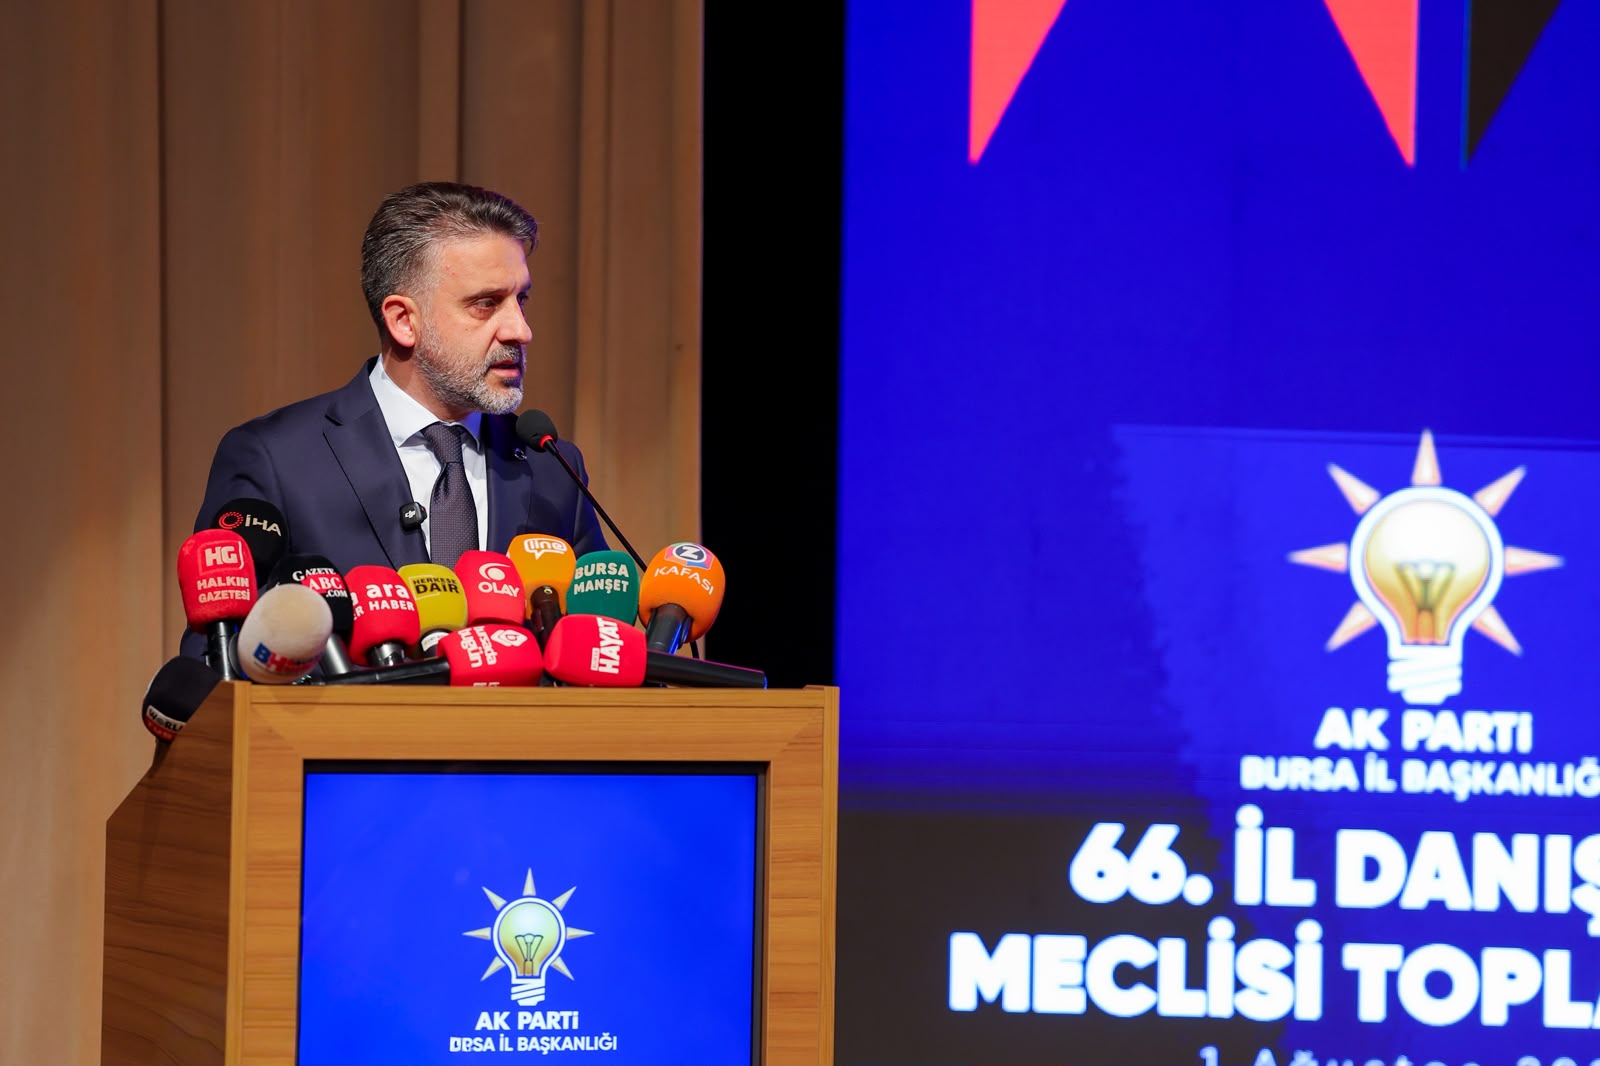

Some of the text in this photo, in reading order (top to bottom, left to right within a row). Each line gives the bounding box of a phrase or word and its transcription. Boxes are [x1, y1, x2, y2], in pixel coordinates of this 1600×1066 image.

[245, 514, 282, 537] İHA
[529, 538, 566, 551] line
[679, 546, 699, 560] Z
[204, 546, 239, 567] HG
[292, 567, 337, 581] GAZETE
[574, 562, 630, 580] BURSA
[196, 576, 250, 590] HALKIN
[309, 577, 343, 590] ABC
[413, 577, 457, 585] HERKESE
[573, 578, 630, 595] MANŞET
[654, 566, 714, 595] KAFASI
[198, 589, 251, 603] GAZETESİ
[326, 589, 349, 598] .COM
[365, 583, 411, 599] ara
[478, 581, 520, 598] OLAY
[368, 600, 416, 611] HABER
[596, 616, 625, 674] HAYAT
[1313, 706, 1391, 751] AK
[1239, 754, 1360, 792] BURSA
[1363, 751, 1398, 793] İL
[1068, 822, 1214, 906] 66.
[1233, 803, 1317, 908] İL
[948, 915, 1600, 1030] MECLİSİ TOPL
[474, 1011, 511, 1031] AK
[499, 1033, 514, 1052] İL
[517, 1031, 618, 1055] BAŞKANLIĞI
